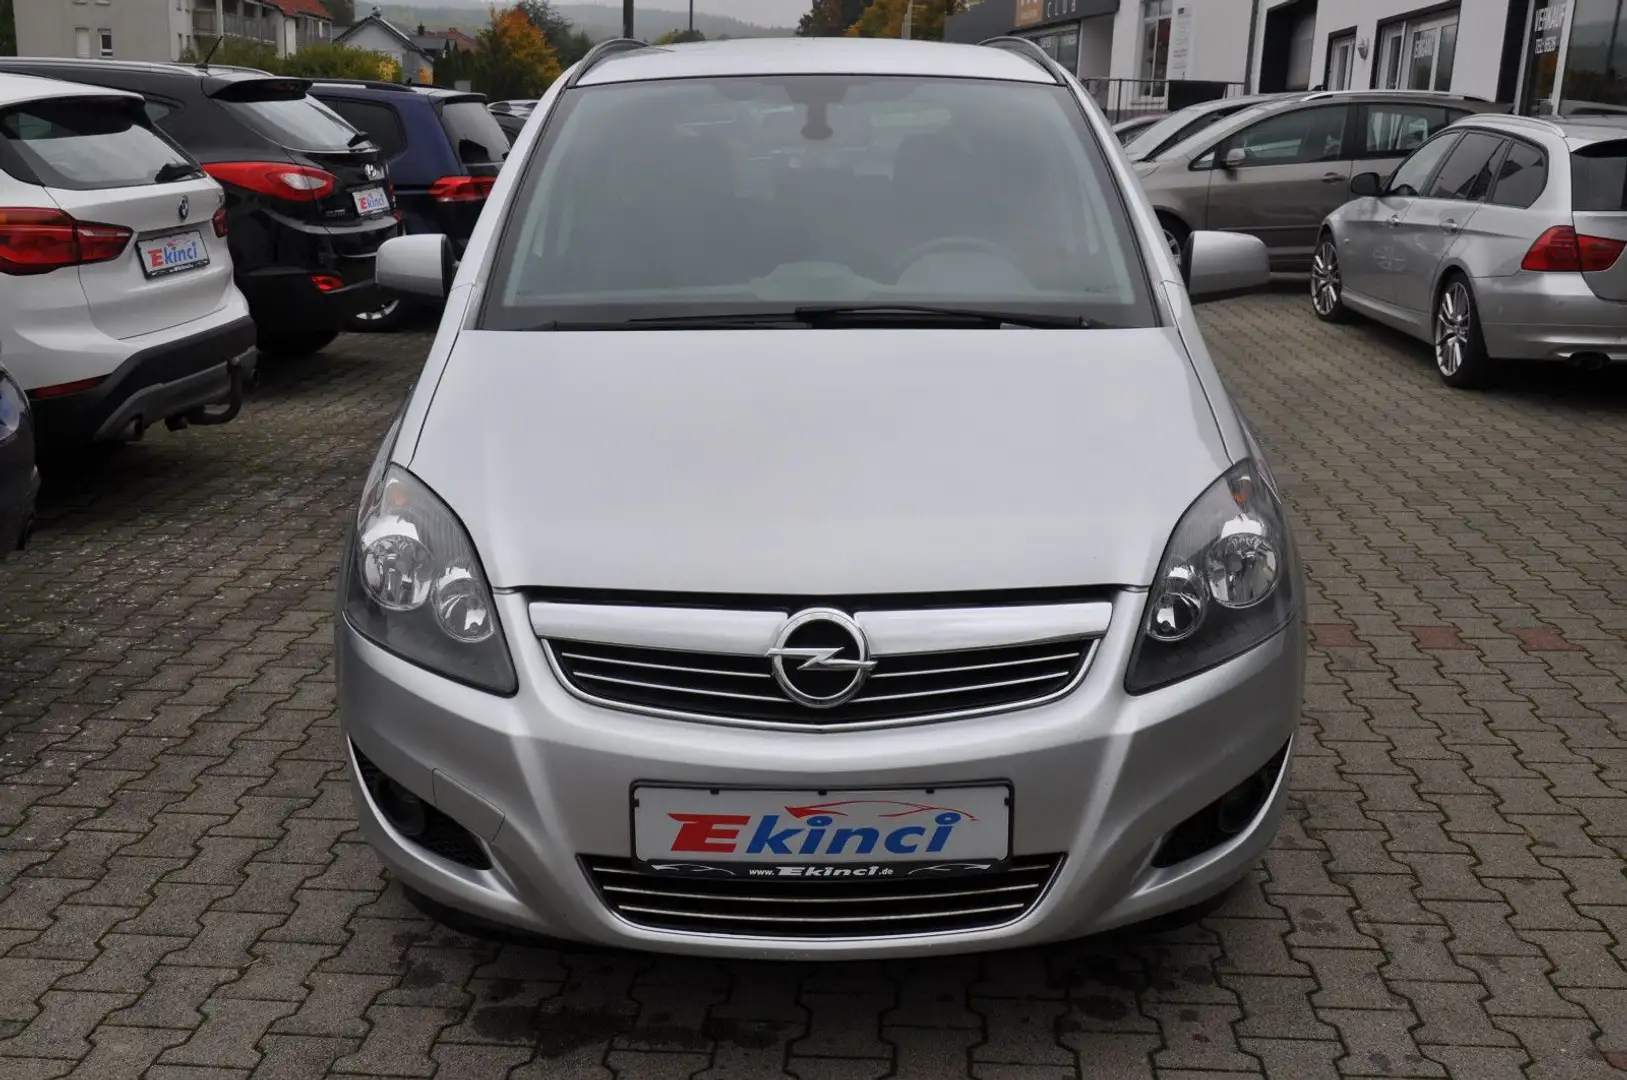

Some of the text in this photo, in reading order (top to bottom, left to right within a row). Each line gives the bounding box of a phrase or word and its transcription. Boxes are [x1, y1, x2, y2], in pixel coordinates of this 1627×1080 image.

[360, 195, 386, 210] Ekinci
[148, 241, 197, 267] Ekinci
[667, 812, 961, 856] Ekinci
[749, 866, 894, 876] www.Ekinci.de
